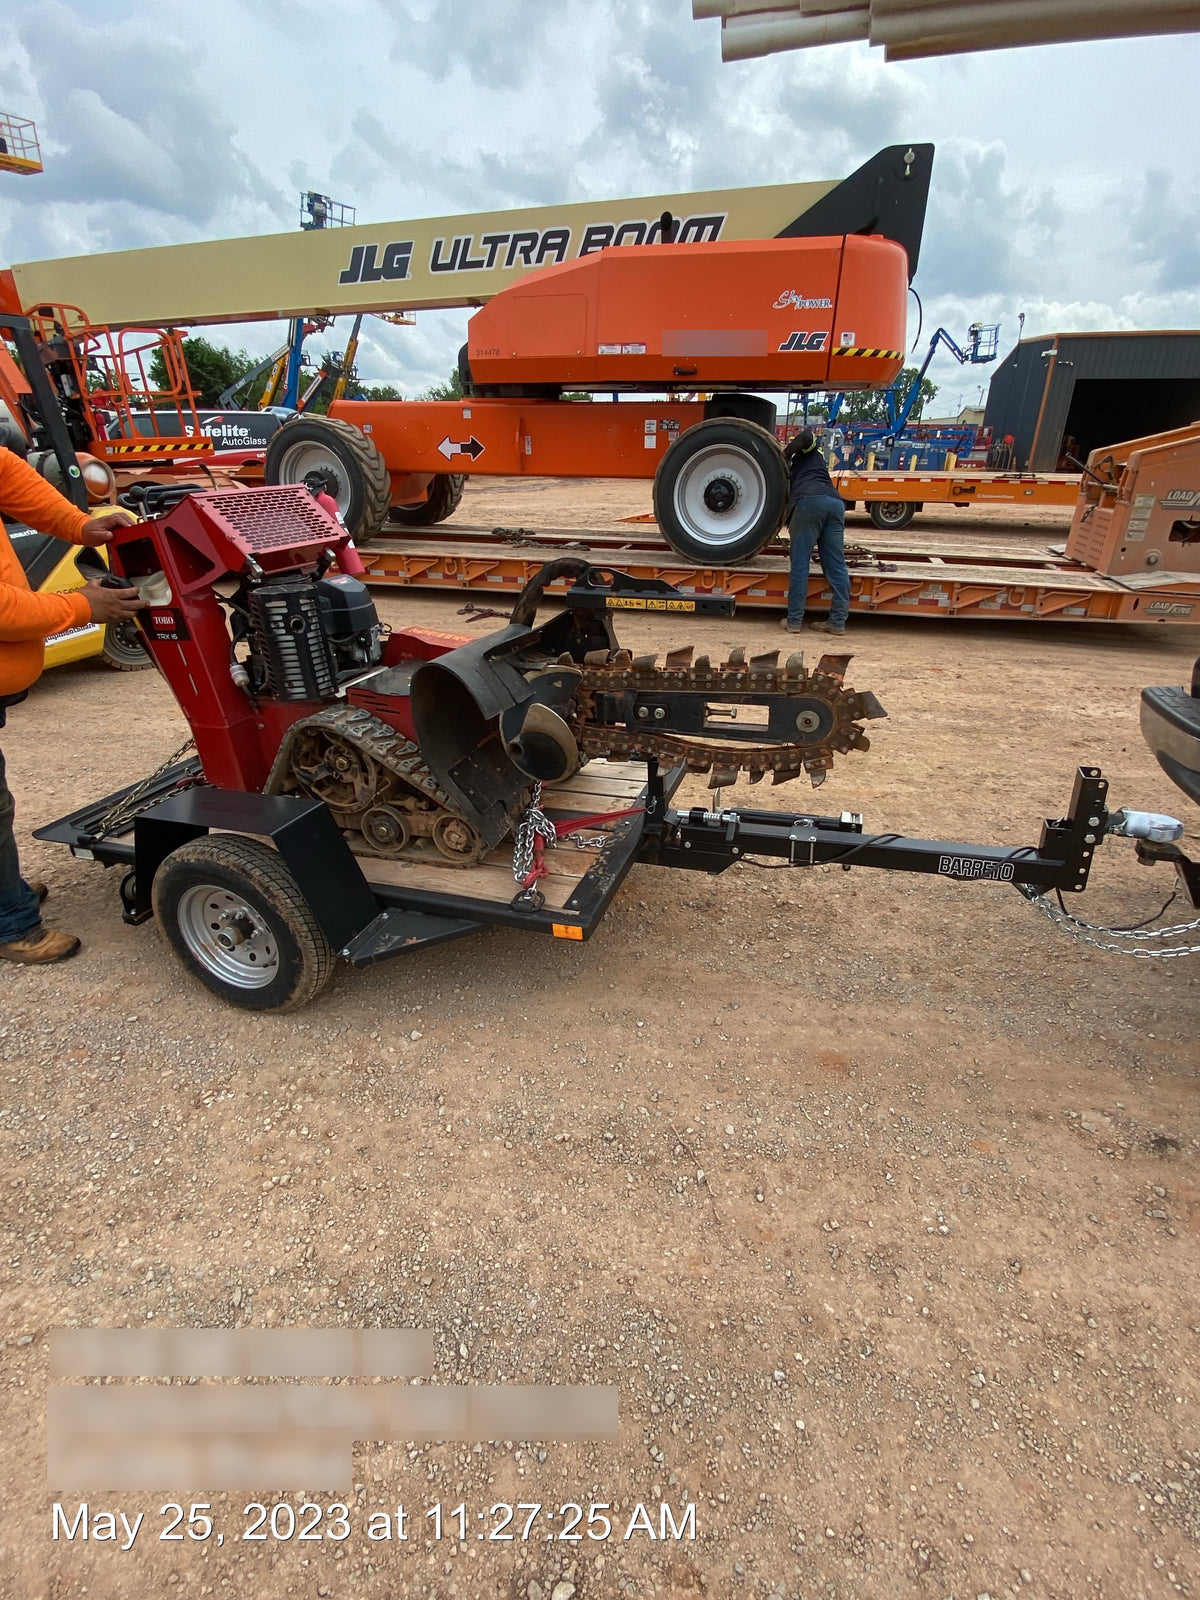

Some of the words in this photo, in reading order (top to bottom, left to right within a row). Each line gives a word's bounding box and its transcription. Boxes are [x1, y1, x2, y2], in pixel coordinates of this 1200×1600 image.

[338, 240, 414, 285] JLG
[429, 227, 572, 274] ULTRA
[578, 212, 728, 258] BOOM
[778, 331, 829, 351] JLG
[221, 436, 267, 446] AutoGlass
[1166, 490, 1193, 501] LOAD
[1171, 606, 1192, 614] KING
[153, 616, 174, 625] TORO
[938, 855, 1015, 881] BARRETO
